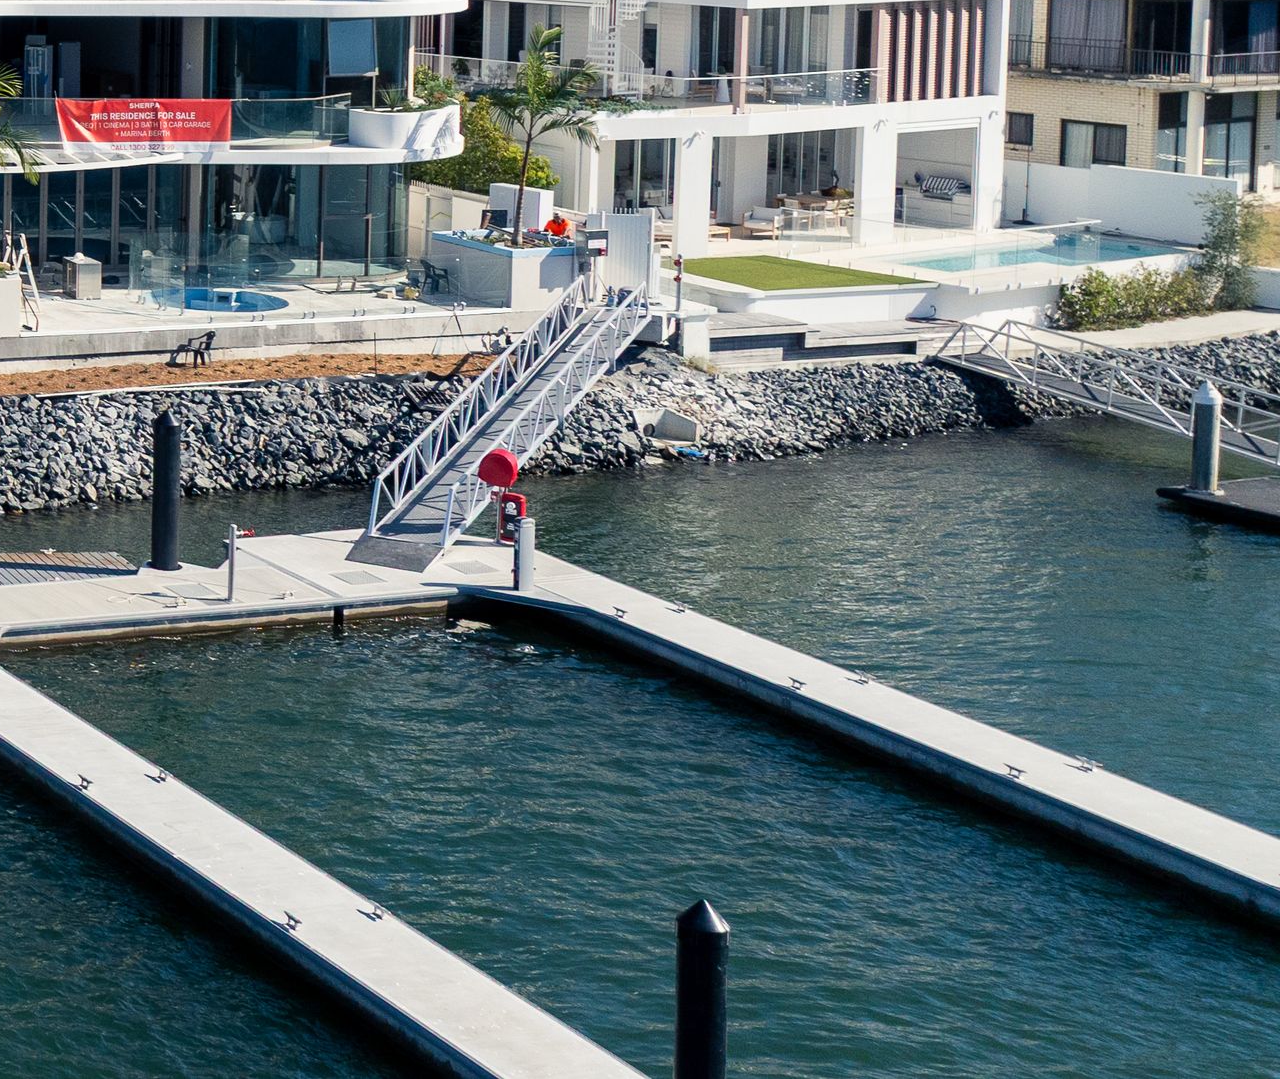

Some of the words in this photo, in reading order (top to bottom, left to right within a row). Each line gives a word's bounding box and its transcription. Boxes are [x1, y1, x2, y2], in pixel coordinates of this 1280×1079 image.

[90, 112, 108, 120] THIS
[110, 112, 156, 120] RESIDENCE
[157, 112, 174, 120] FOR
[175, 112, 196, 120] SALE
